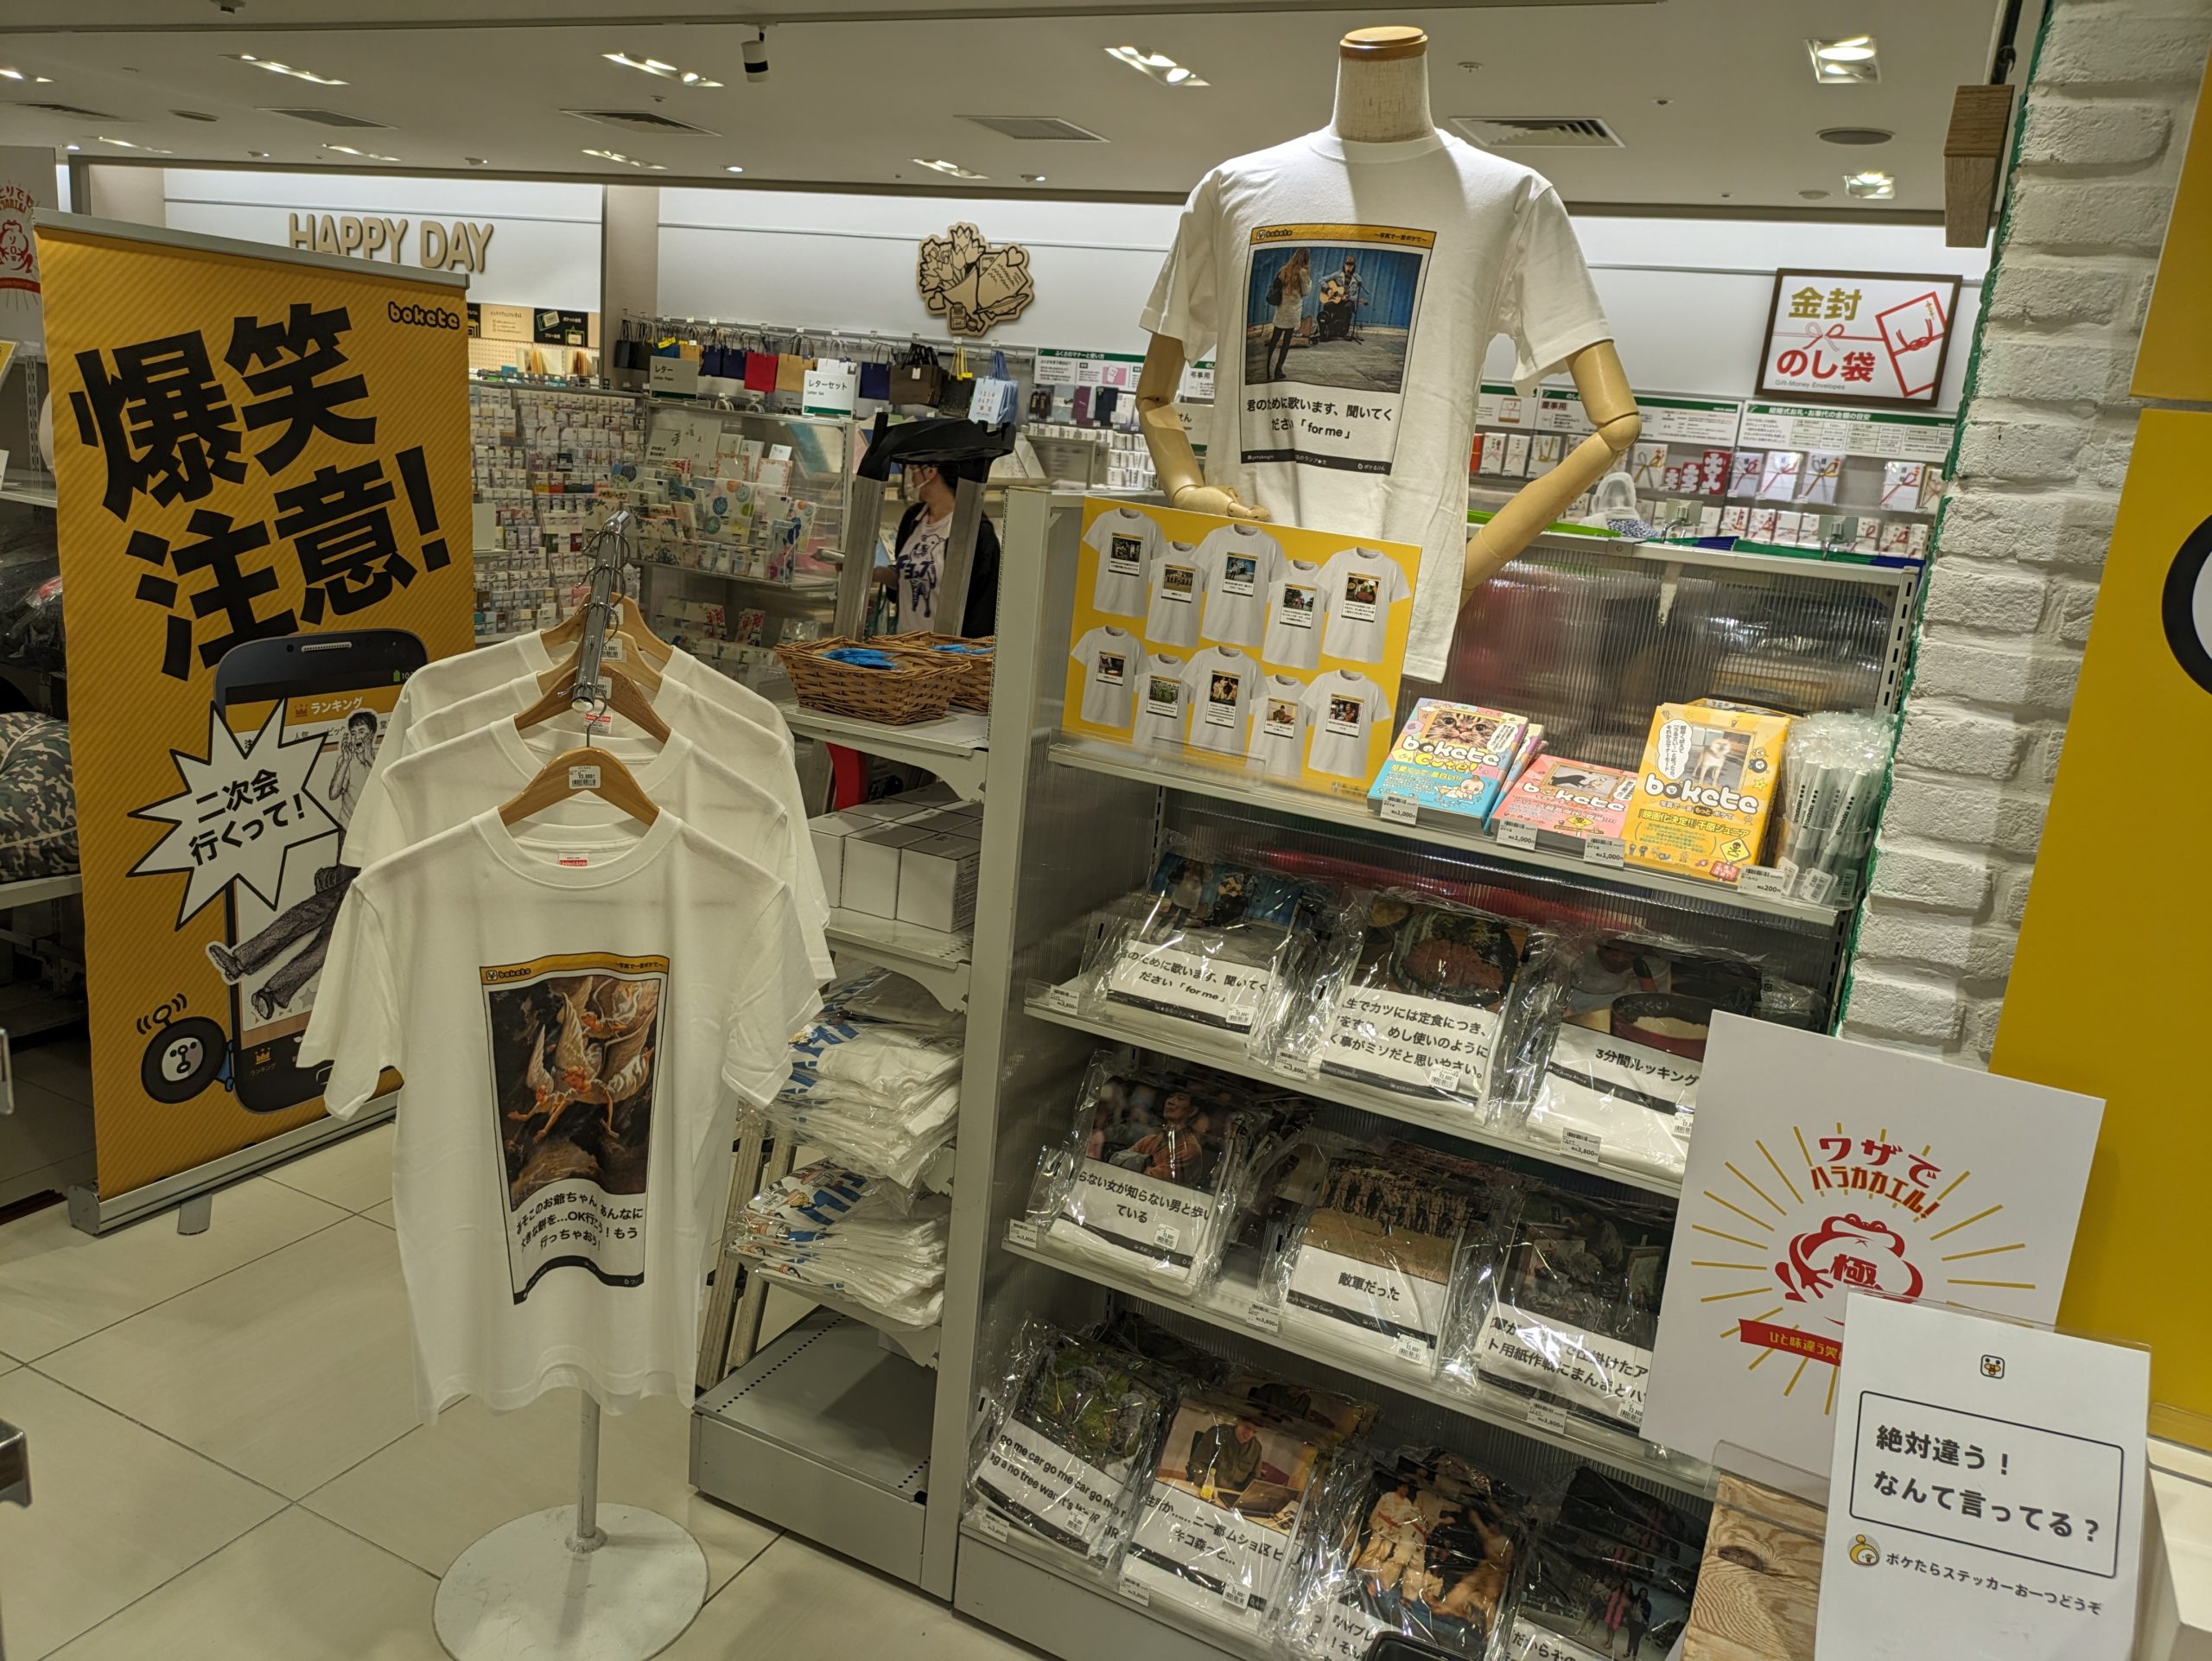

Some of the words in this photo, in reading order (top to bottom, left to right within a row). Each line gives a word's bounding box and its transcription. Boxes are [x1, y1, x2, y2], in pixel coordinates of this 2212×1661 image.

[289, 213, 408, 268] HAPPY
[419, 220, 493, 272] DAY
[388, 302, 460, 330] bokete
[1788, 287, 1862, 321] 金封
[1777, 349, 1876, 383] のし袋
[809, 379, 848, 390] レターセット
[69, 303, 377, 522] 爆笑
[1247, 397, 1393, 421] 君のために歌います、聞いてく
[125, 445, 451, 682] 注意!
[311, 697, 364, 715] ランキング
[1402, 735, 1500, 767] bokete
[1414, 753, 1478, 772] Cute!
[196, 769, 279, 824] 二次会
[1522, 782, 1625, 811] bokete
[1644, 773, 1759, 814] bokete
[188, 794, 306, 865] 行くって!
[1697, 819, 1751, 837] 千原ジュニア
[1596, 1048, 1700, 1086] 3分間ルッキング
[1818, 1137, 1942, 1189] ワザで
[1810, 1166, 1942, 1219] ハラカカエル!
[1116, 1204, 1147, 1224] ている
[1338, 1272, 1400, 1301] 敵軍だった
[1830, 1253, 1878, 1289] 極
[1876, 1424, 2009, 1475] 絶対違う!
[1001, 1461, 1007, 1469] a
[1008, 1465, 1020, 1476] no
[1020, 1472, 1039, 1489] tree
[1014, 1442, 1028, 1456] me
[1028, 1451, 1044, 1467] car
[1043, 1461, 1057, 1474] go
[1058, 1469, 1074, 1485] me
[1074, 1480, 1090, 1494] car
[1089, 1490, 1103, 1504] go
[1873, 1471, 2100, 1543] なんて言ってる?
